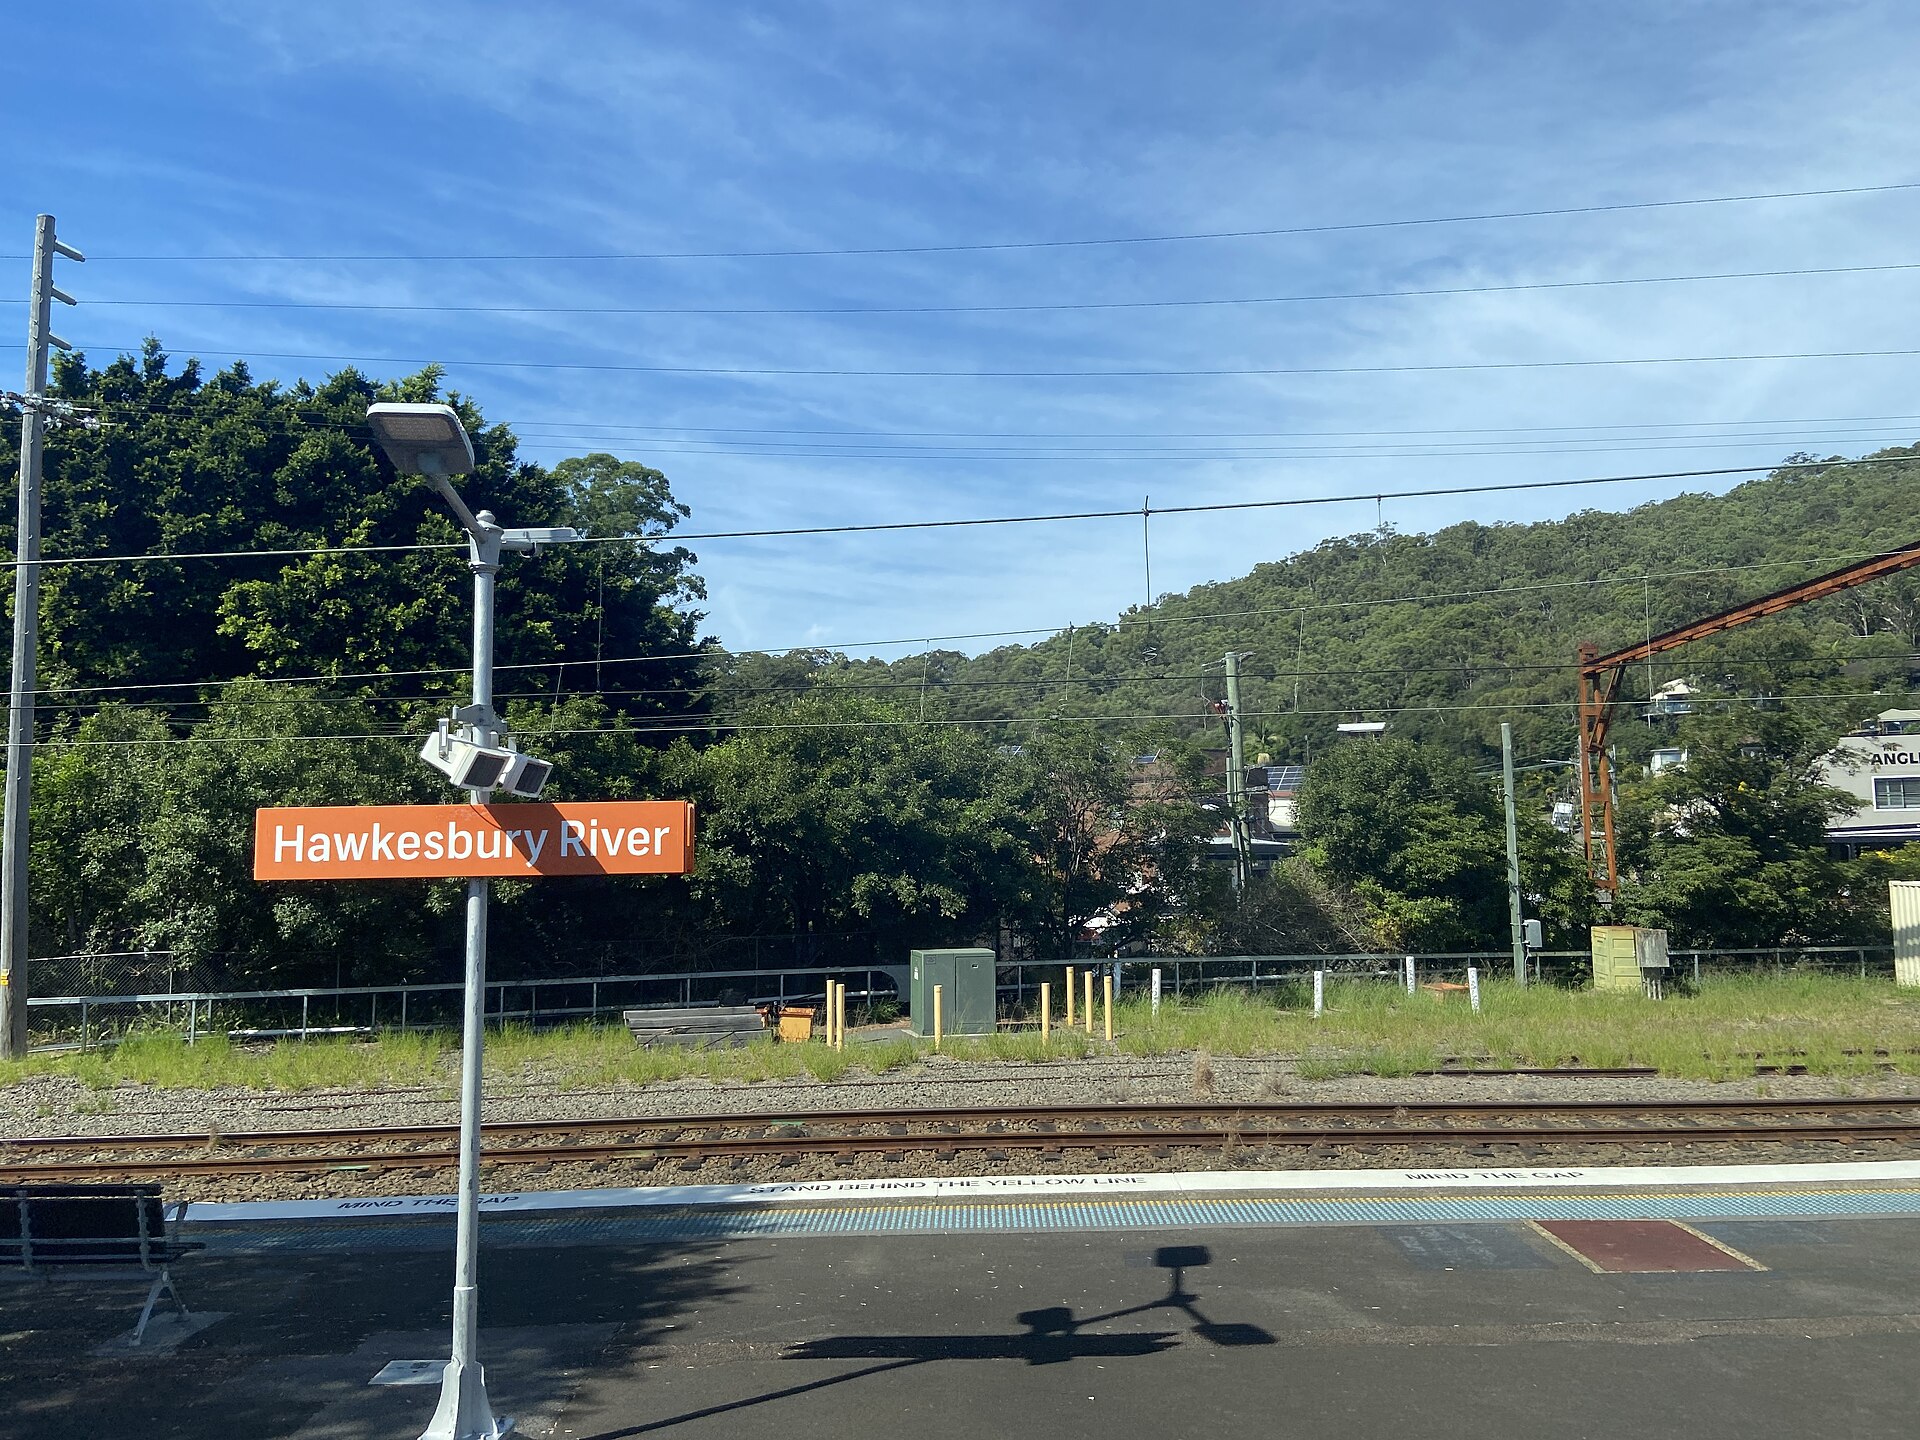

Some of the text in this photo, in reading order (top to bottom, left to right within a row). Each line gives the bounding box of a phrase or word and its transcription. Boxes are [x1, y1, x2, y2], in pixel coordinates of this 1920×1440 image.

[1871, 753, 1920, 765] ANGL
[274, 819, 670, 866] Hawkesbury River
[749, 1185, 831, 1193] STAND
[838, 1182, 927, 1190] BEHIND
[986, 1178, 1087, 1186] YELLOW
[337, 1200, 403, 1209] MIND
[412, 1198, 457, 1206] THE
